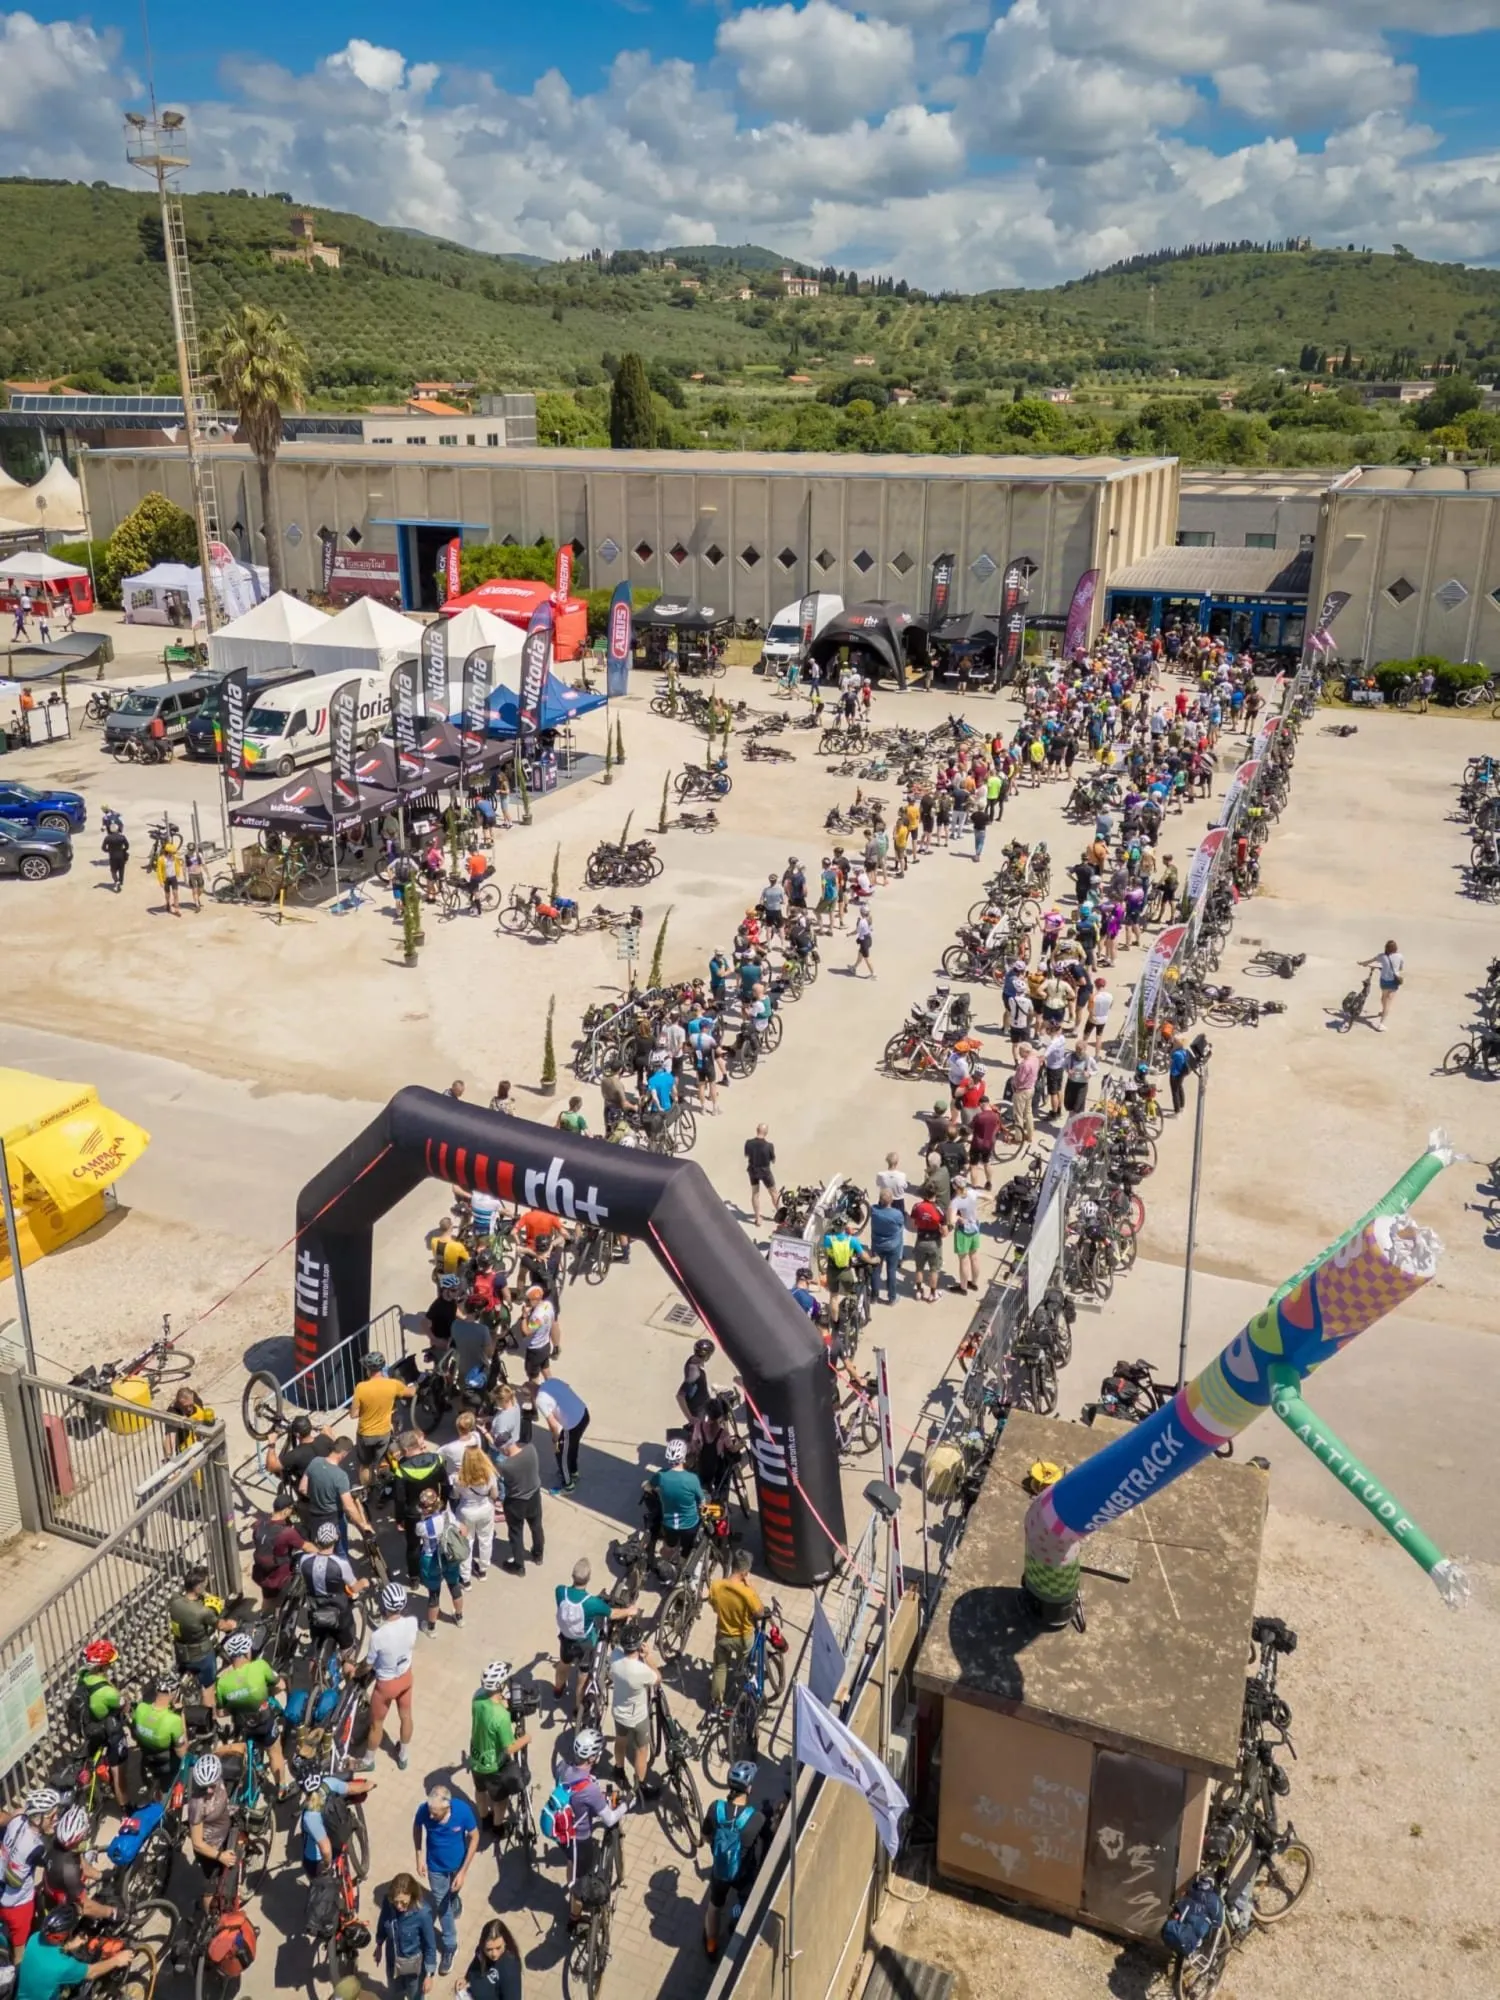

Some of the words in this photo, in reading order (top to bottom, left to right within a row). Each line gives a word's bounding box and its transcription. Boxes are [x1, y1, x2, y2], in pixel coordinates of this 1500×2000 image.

[425, 630, 445, 701] vittoria
[614, 610, 627, 652] ABUS
[466, 656, 488, 732] vittoria
[522, 639, 546, 711] vittoria
[222, 682, 245, 769] vittoria
[333, 693, 355, 781] vittoria
[395, 673, 418, 753] vittoria
[72, 1135, 125, 1179] CAMPAGNA
[93, 1151, 127, 1180] AMICA
[524, 1156, 609, 1226] rh+
[296, 1249, 320, 1317] rh+
[751, 1413, 788, 1487] rh+
[1296, 1424, 1414, 1538] ATTITUDE
